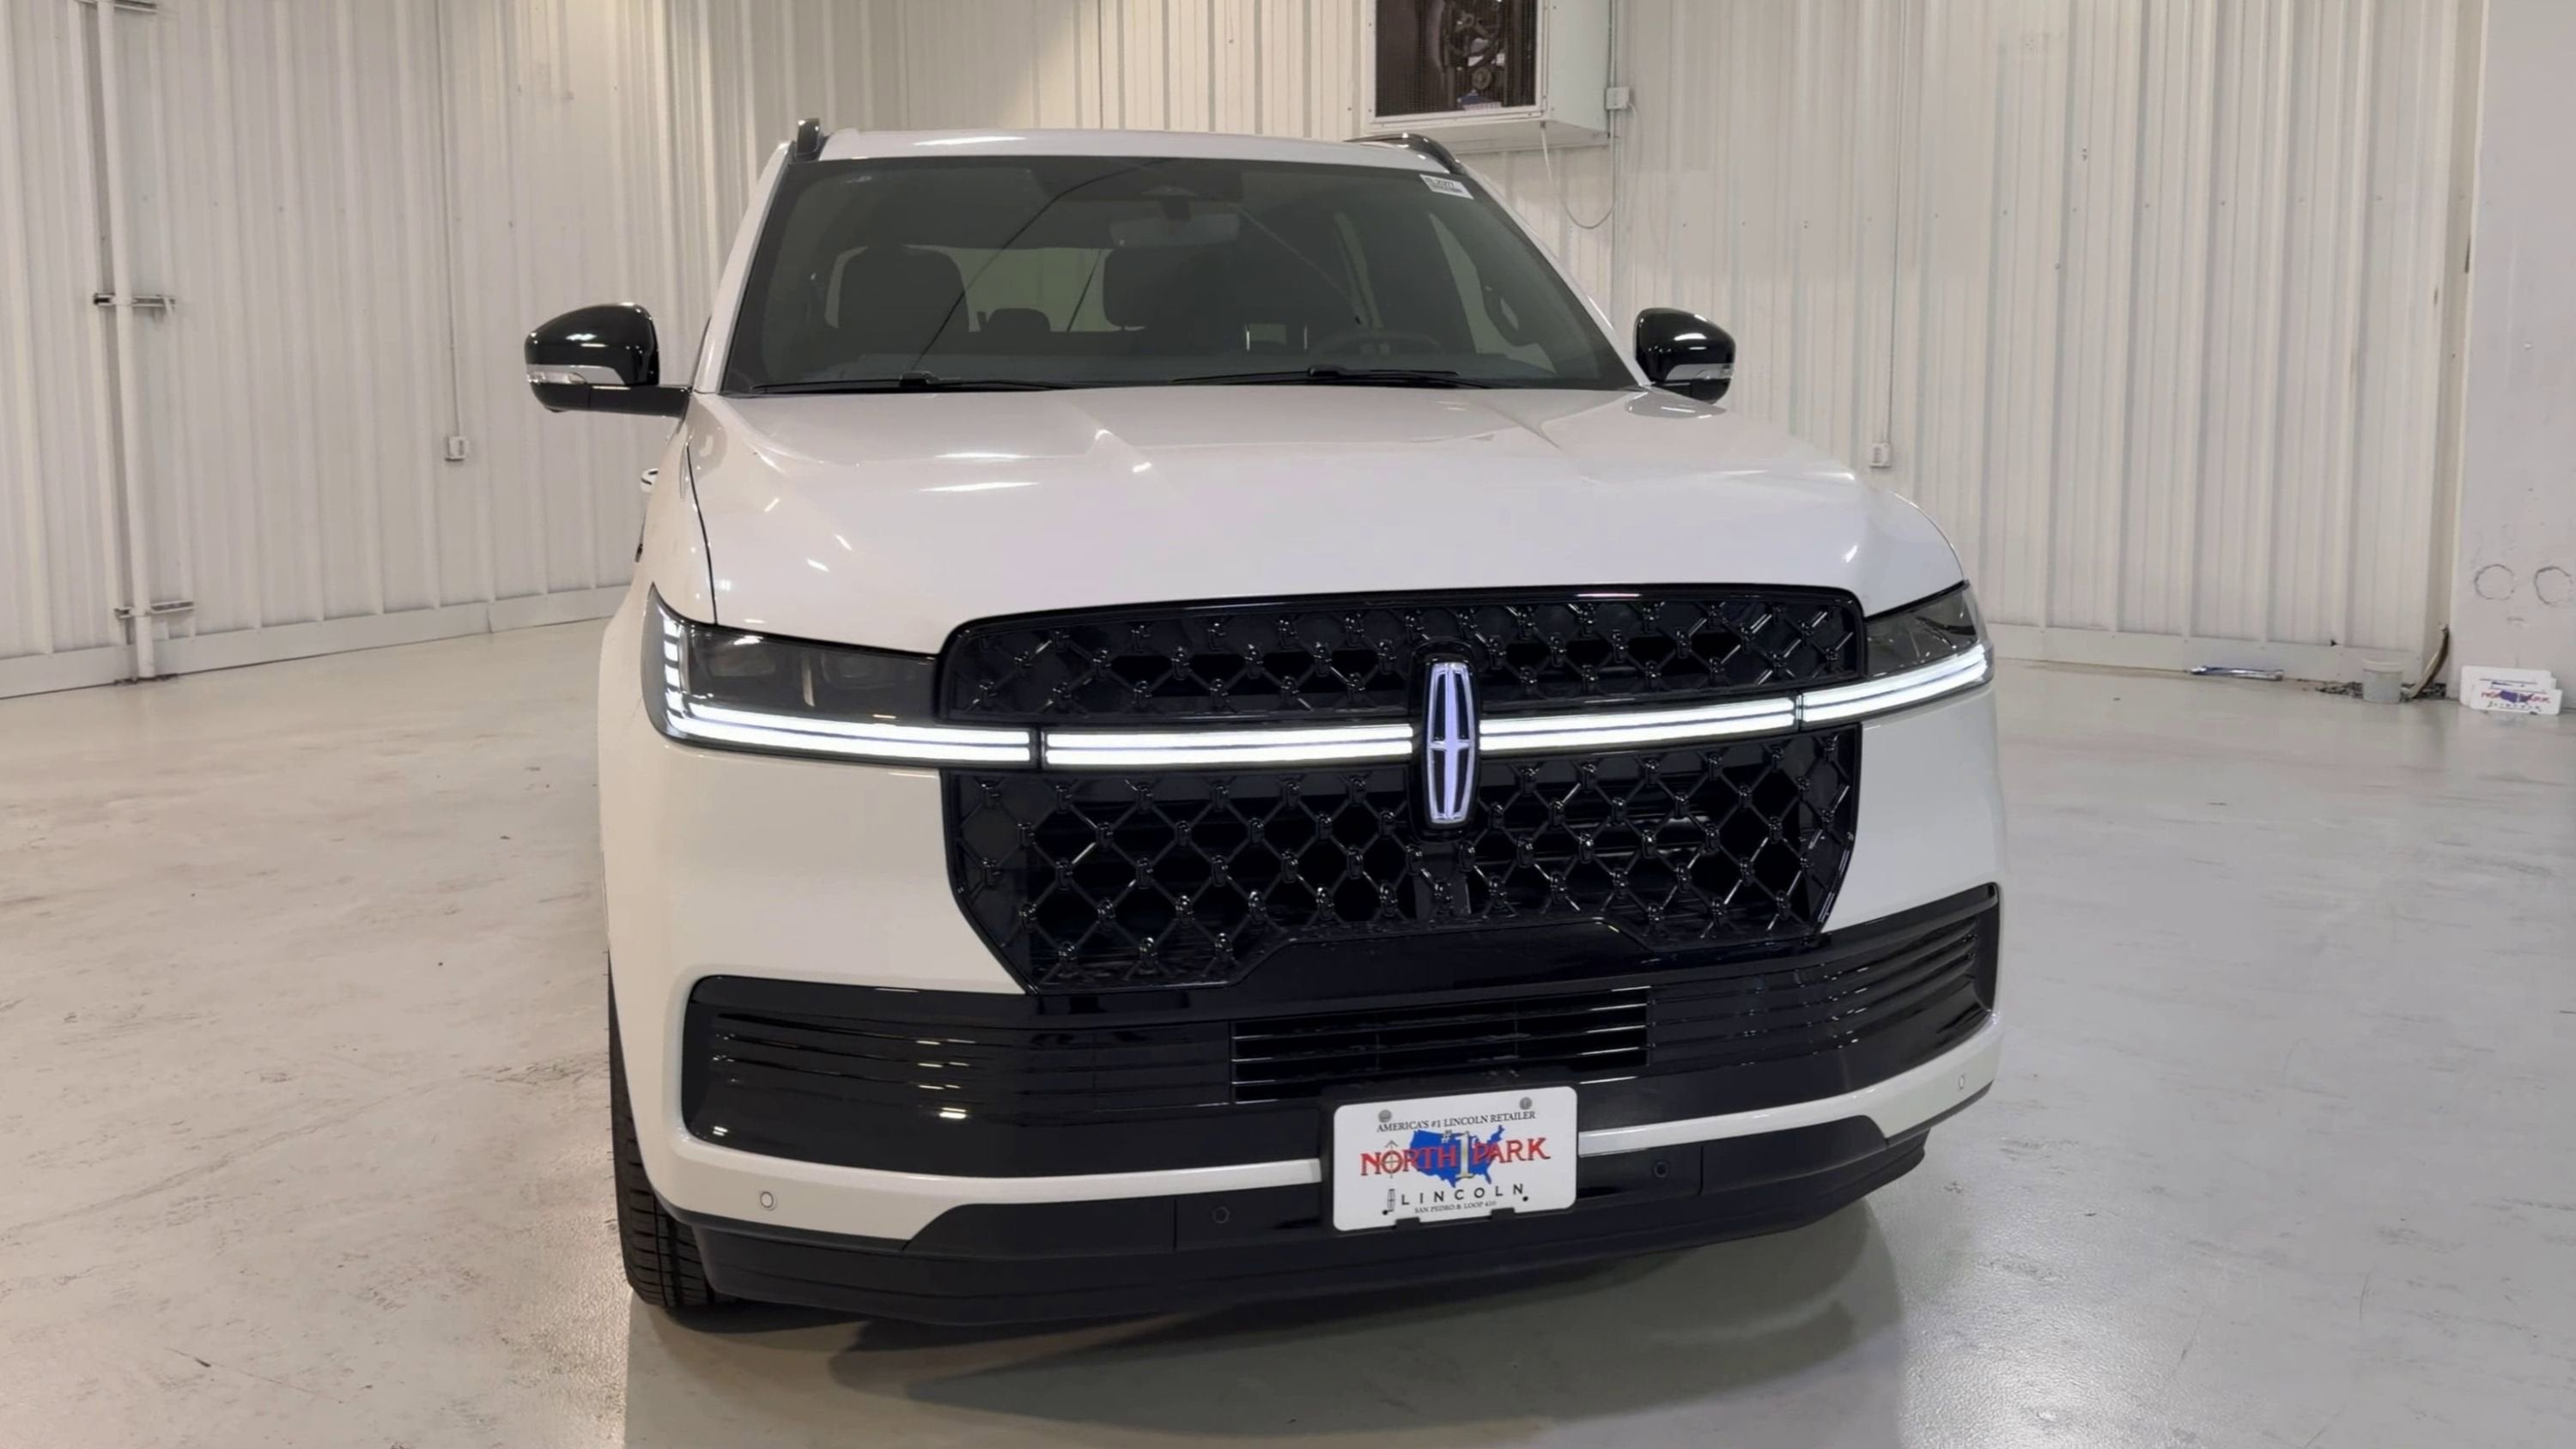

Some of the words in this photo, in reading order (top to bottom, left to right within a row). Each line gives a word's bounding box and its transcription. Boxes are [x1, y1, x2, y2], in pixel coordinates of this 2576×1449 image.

[1376, 1120, 1430, 1133] AMERICA'S
[1431, 1119, 1442, 1128] #1
[1443, 1114, 1490, 1127] LINCOLN
[1490, 1110, 1536, 1123] RETAILER
[1360, 1145, 1457, 1177] NORTH
[1473, 1137, 1552, 1165] PARK
[1401, 1183, 1524, 1206] LINCOLN
